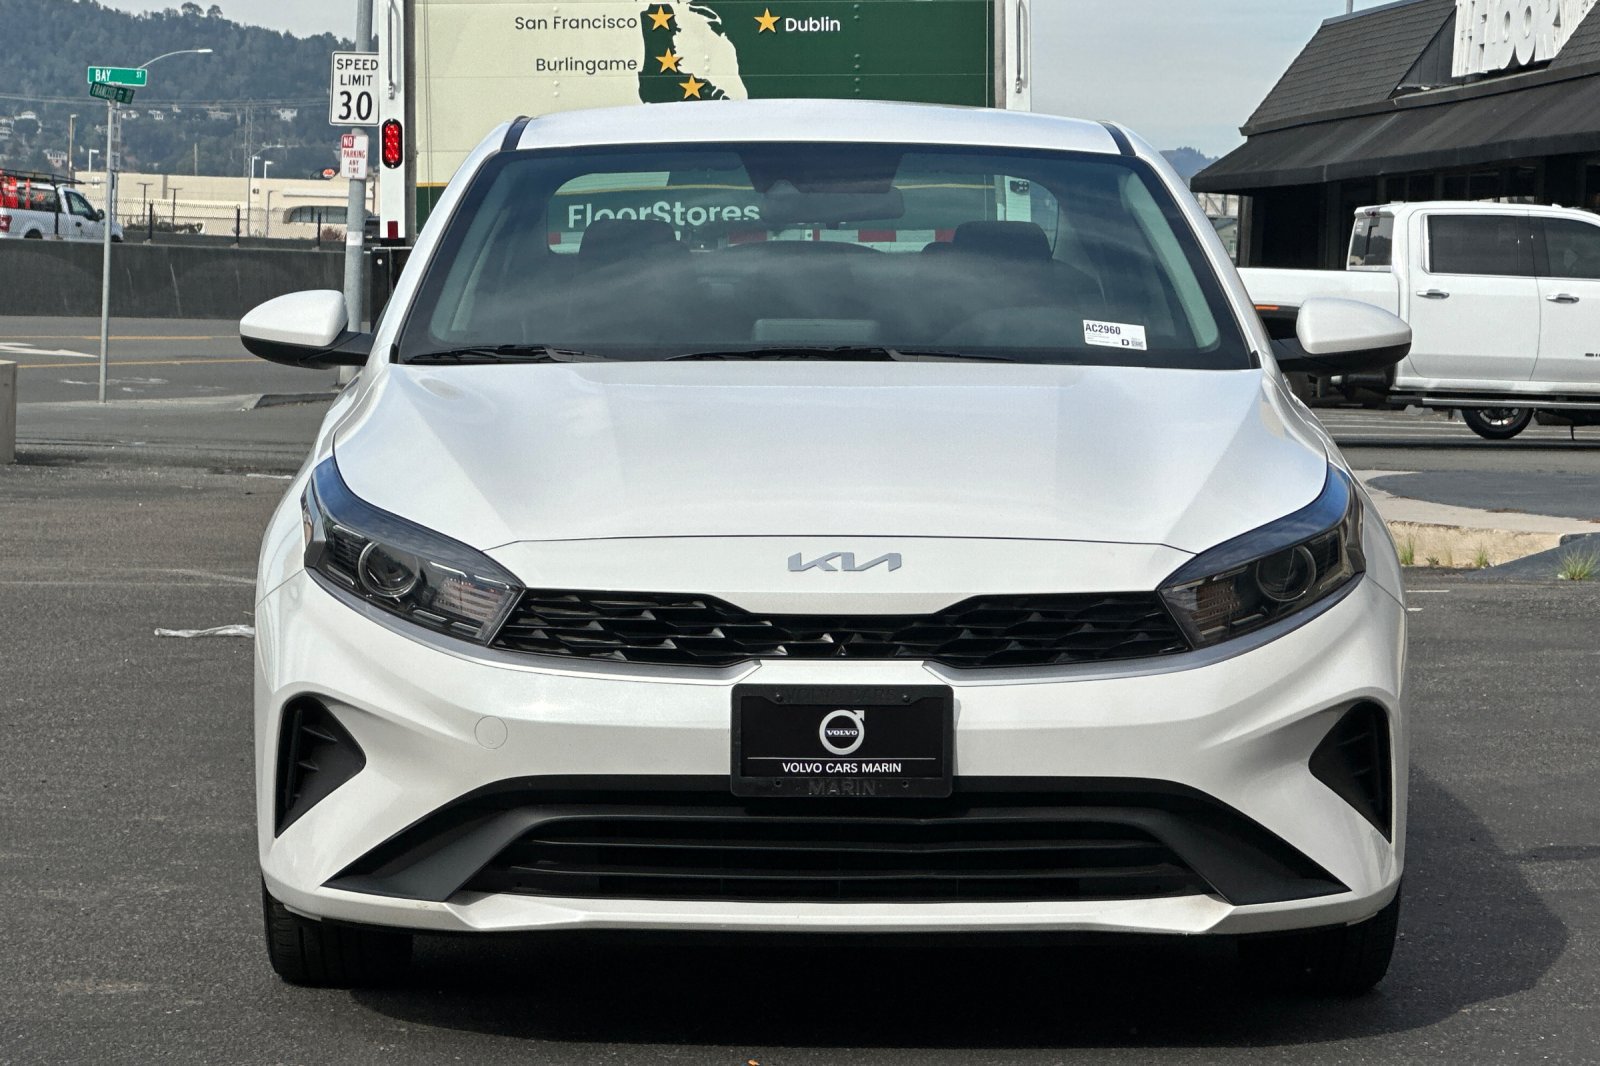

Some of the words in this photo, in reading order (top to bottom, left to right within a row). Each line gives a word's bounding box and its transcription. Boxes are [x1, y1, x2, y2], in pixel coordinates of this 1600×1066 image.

[514, 16, 548, 30] San
[553, 15, 638, 30] Francisco
[785, 17, 841, 32] Dublin
[336, 58, 379, 71] SPEED
[536, 57, 638, 75] Burlingame
[95, 69, 112, 82] BAY
[135, 71, 143, 79] ST
[340, 74, 373, 86] LIMIT
[338, 91, 373, 121] 30
[343, 136, 353, 147] NO
[343, 149, 366, 159] PARKING
[348, 166, 359, 174] TIME
[1085, 323, 1121, 335] AC2960
[1121, 338, 1130, 346] D
[787, 551, 902, 572] KIA
[782, 762, 823, 773] VOLVO
[825, 762, 858, 773] CARS
[861, 762, 902, 773] MARIN
[808, 779, 876, 796] MARIN
